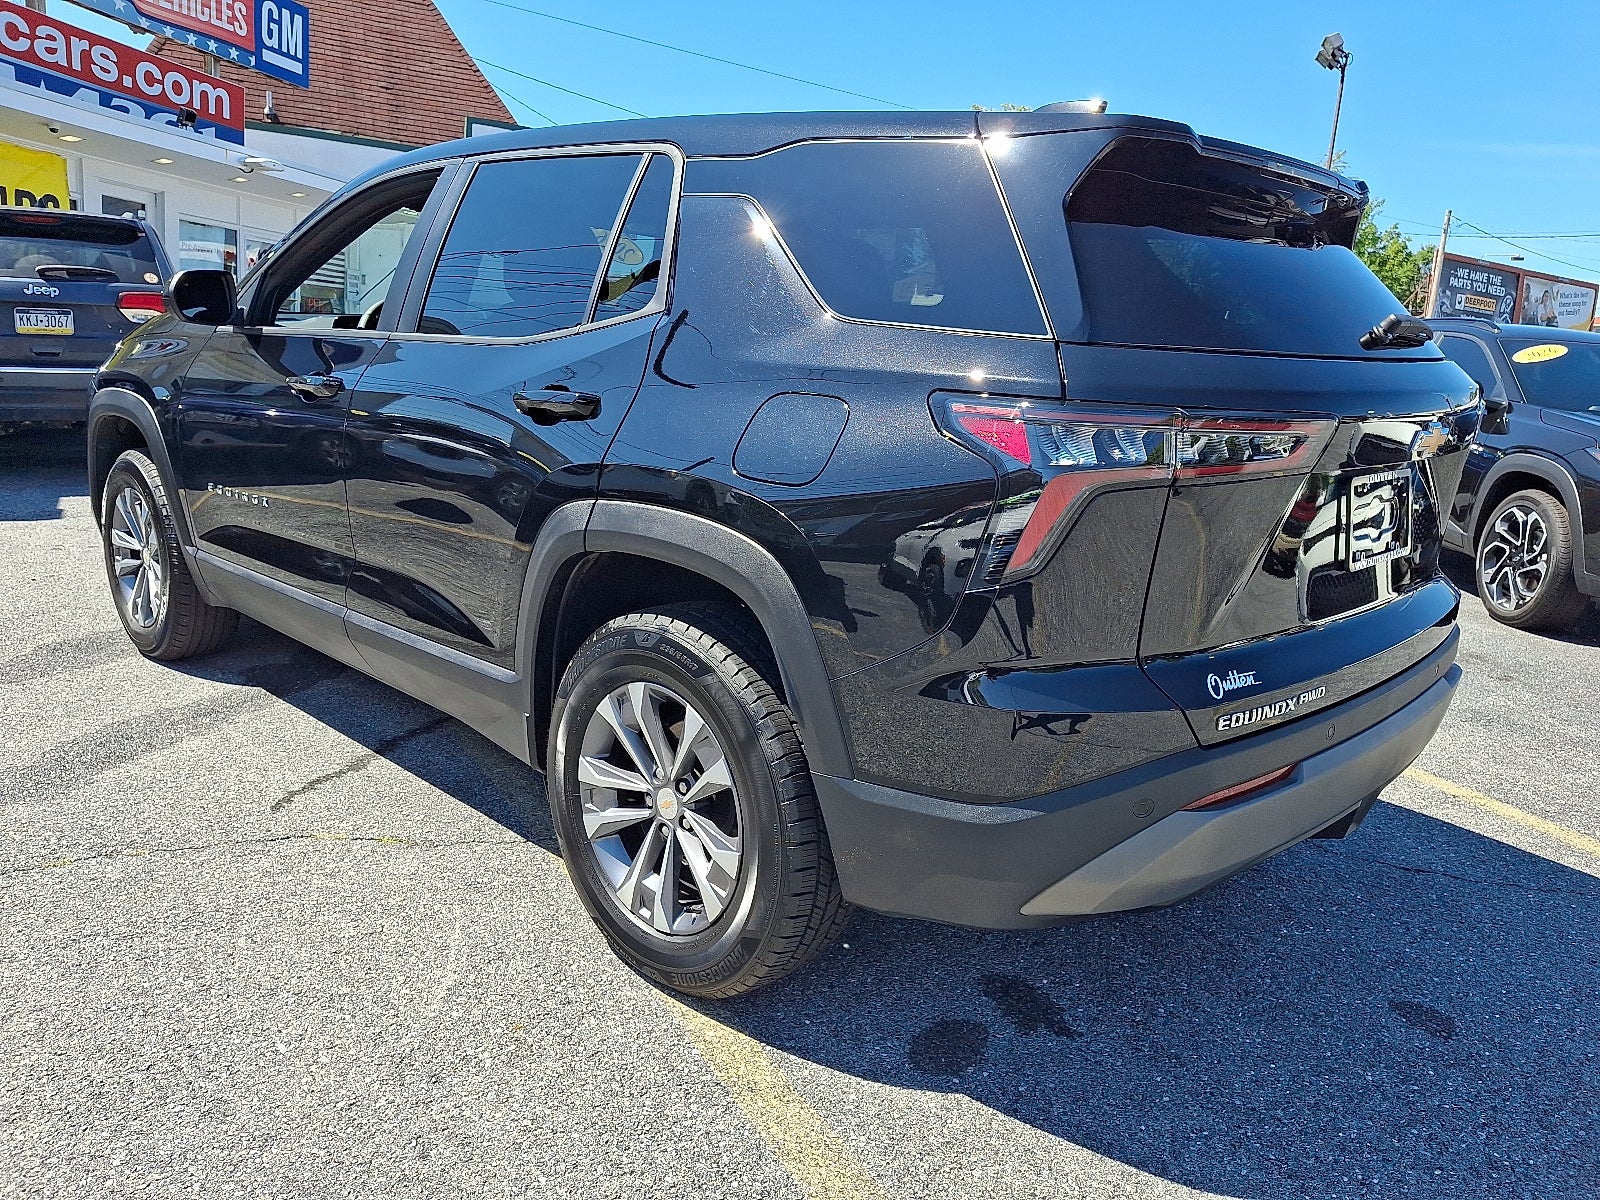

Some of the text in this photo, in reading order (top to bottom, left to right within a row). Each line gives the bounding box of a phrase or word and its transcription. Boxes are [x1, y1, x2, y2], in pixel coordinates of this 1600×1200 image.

[146, 0, 248, 37] ICLES
[261, 0, 303, 60] GM
[0, 11, 230, 120] cars.com
[23, 283, 60, 298] Jeep
[1449, 276, 1506, 297] PARTS YOU NEED
[1457, 267, 1503, 286] WE HAVE THE
[1465, 296, 1496, 309] DEERFOOT
[207, 482, 269, 508] EQUINOX
[1206, 669, 1263, 700] Outten
[1217, 686, 1326, 731] EQUINOX AWD
